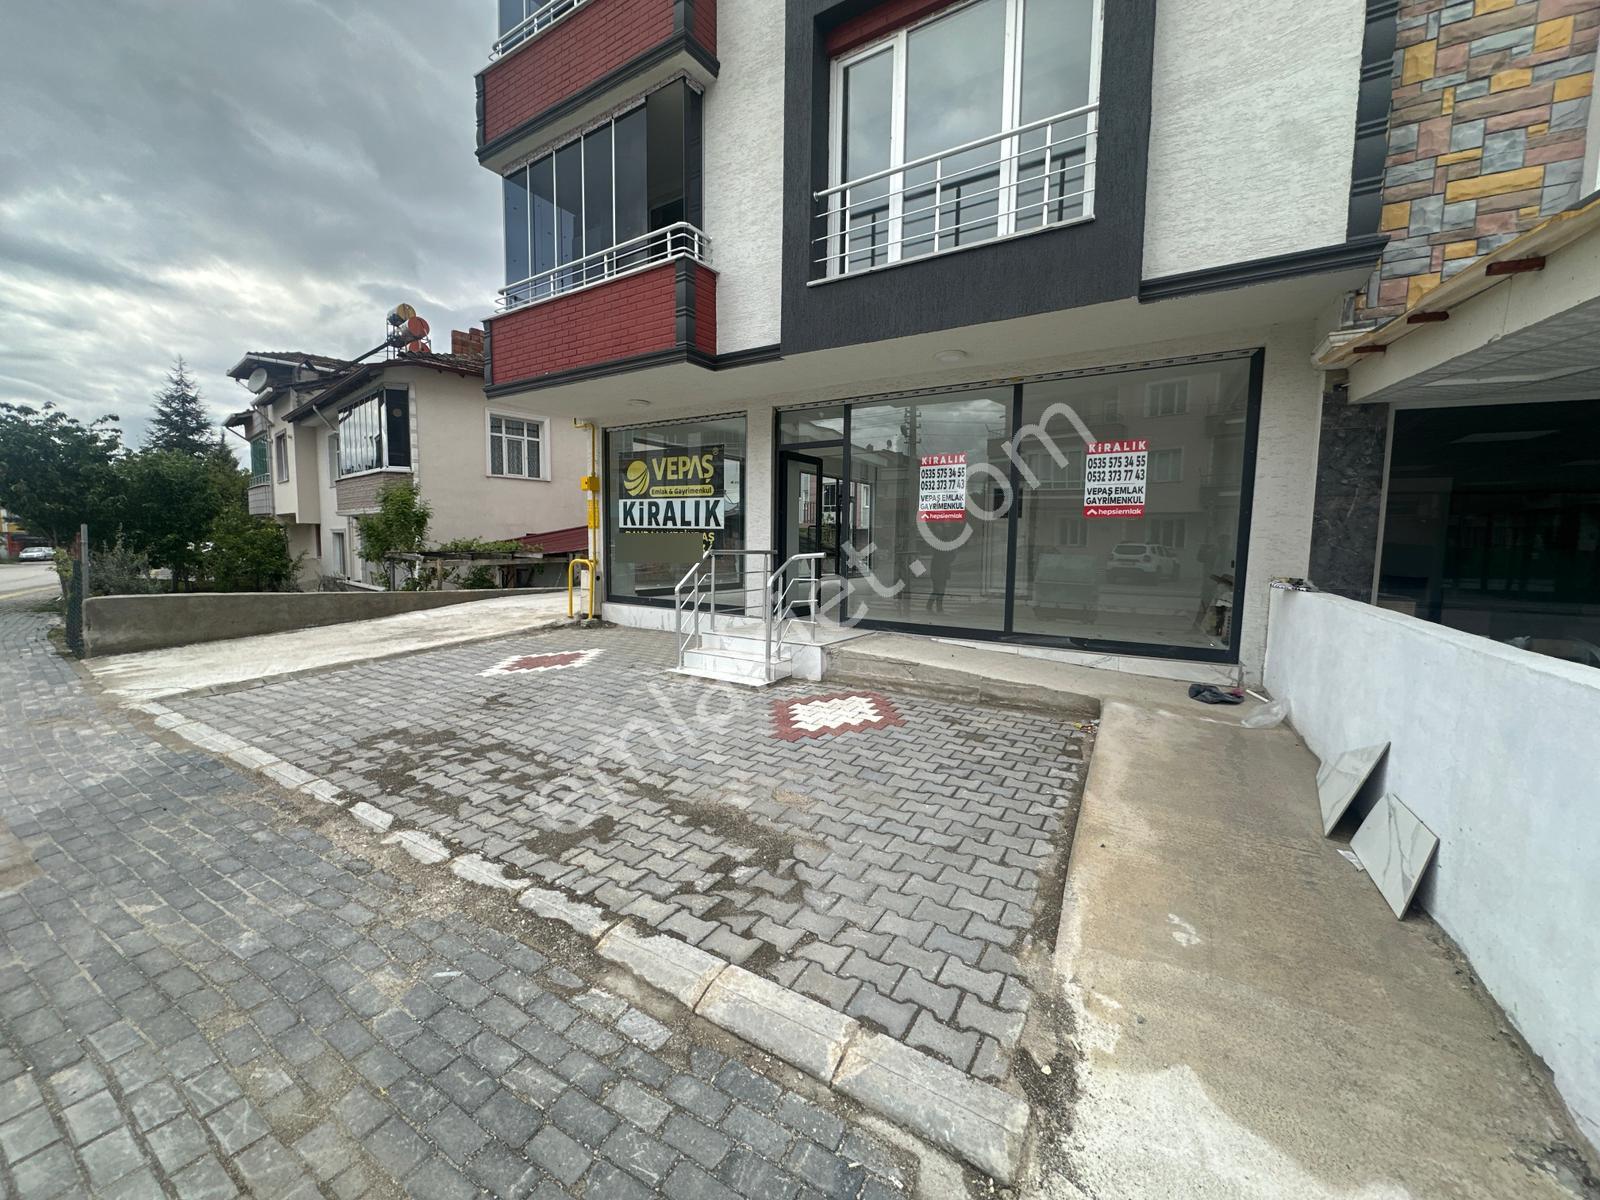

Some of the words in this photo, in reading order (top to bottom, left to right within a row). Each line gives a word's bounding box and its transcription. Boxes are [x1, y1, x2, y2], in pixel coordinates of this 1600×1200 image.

[1088, 458, 1106, 469] 0535
[1108, 457, 1122, 468] 575
[1124, 456, 1134, 467] 34
[1136, 455, 1146, 467] 55
[652, 454, 714, 483] VEPAŞ
[921, 469, 935, 479] 0535
[937, 468, 947, 478] 575
[949, 468, 956, 477] 34
[958, 467, 965, 477] 55
[1087, 471, 1106, 482] 0532
[1108, 470, 1121, 481] 373
[1124, 470, 1133, 481] 77
[1135, 469, 1144, 480] 43
[921, 480, 935, 490] 0532
[937, 480, 946, 490] 373
[949, 480, 955, 489] 77
[674, 487, 712, 495] Gayrimenkul
[1087, 487, 1113, 496] VEPAŞ
[1115, 486, 1143, 494] EMLAK
[921, 494, 940, 502] VEPAŞ
